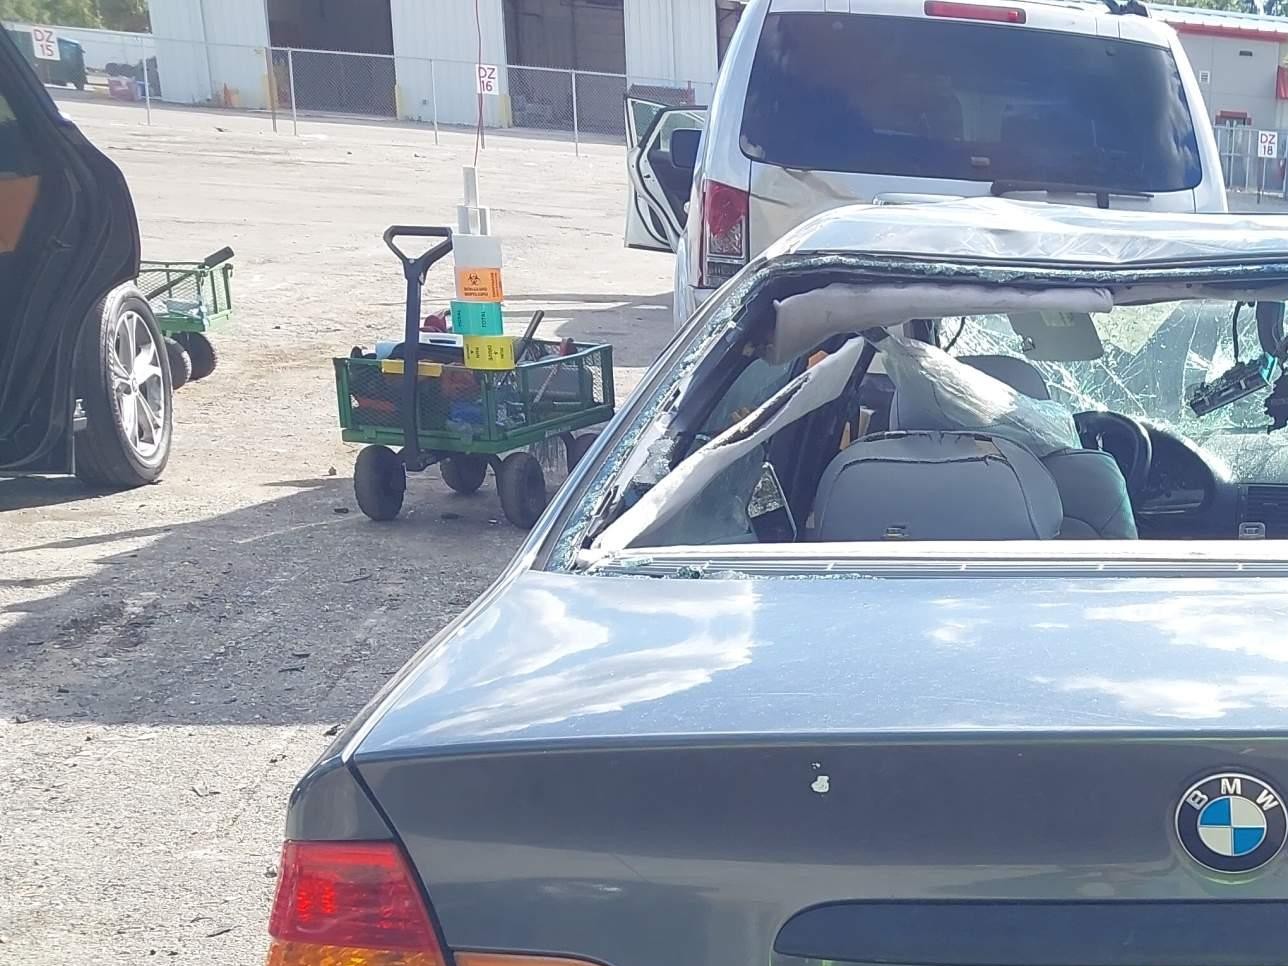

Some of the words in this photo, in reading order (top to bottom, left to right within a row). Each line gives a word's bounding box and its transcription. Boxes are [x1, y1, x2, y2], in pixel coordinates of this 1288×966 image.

[33, 29, 55, 43] DZ
[40, 44, 54, 56] 15
[478, 66, 496, 80] DZ
[481, 80, 493, 91] 16
[1260, 133, 1276, 144] DZ
[1263, 145, 1273, 156] 18
[1185, 778, 1279, 811] BMW
